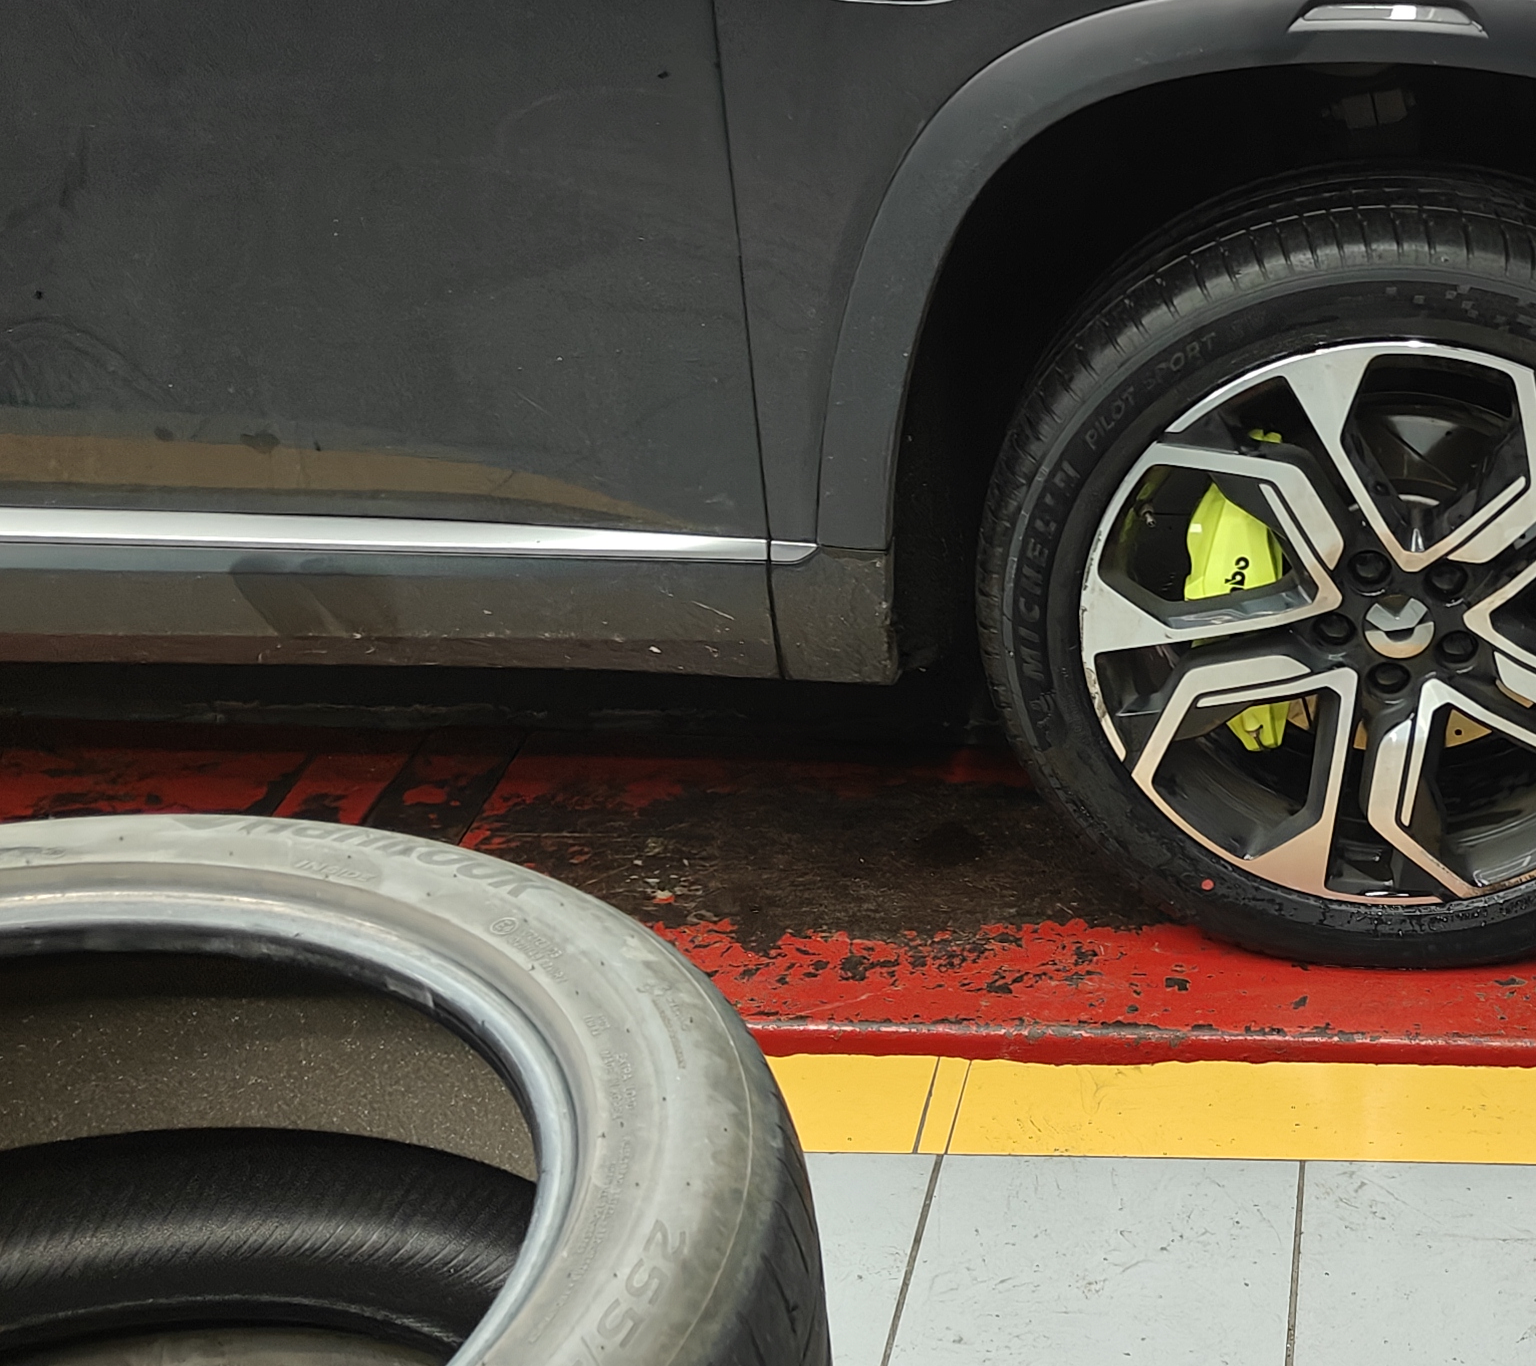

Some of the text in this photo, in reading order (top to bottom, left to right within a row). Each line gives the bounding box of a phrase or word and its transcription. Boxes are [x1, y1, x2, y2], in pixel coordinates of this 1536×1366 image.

[1019, 460, 1081, 681] MICHELIN
[1085, 387, 1135, 450] PILOT
[1147, 332, 1216, 389] SPORT
